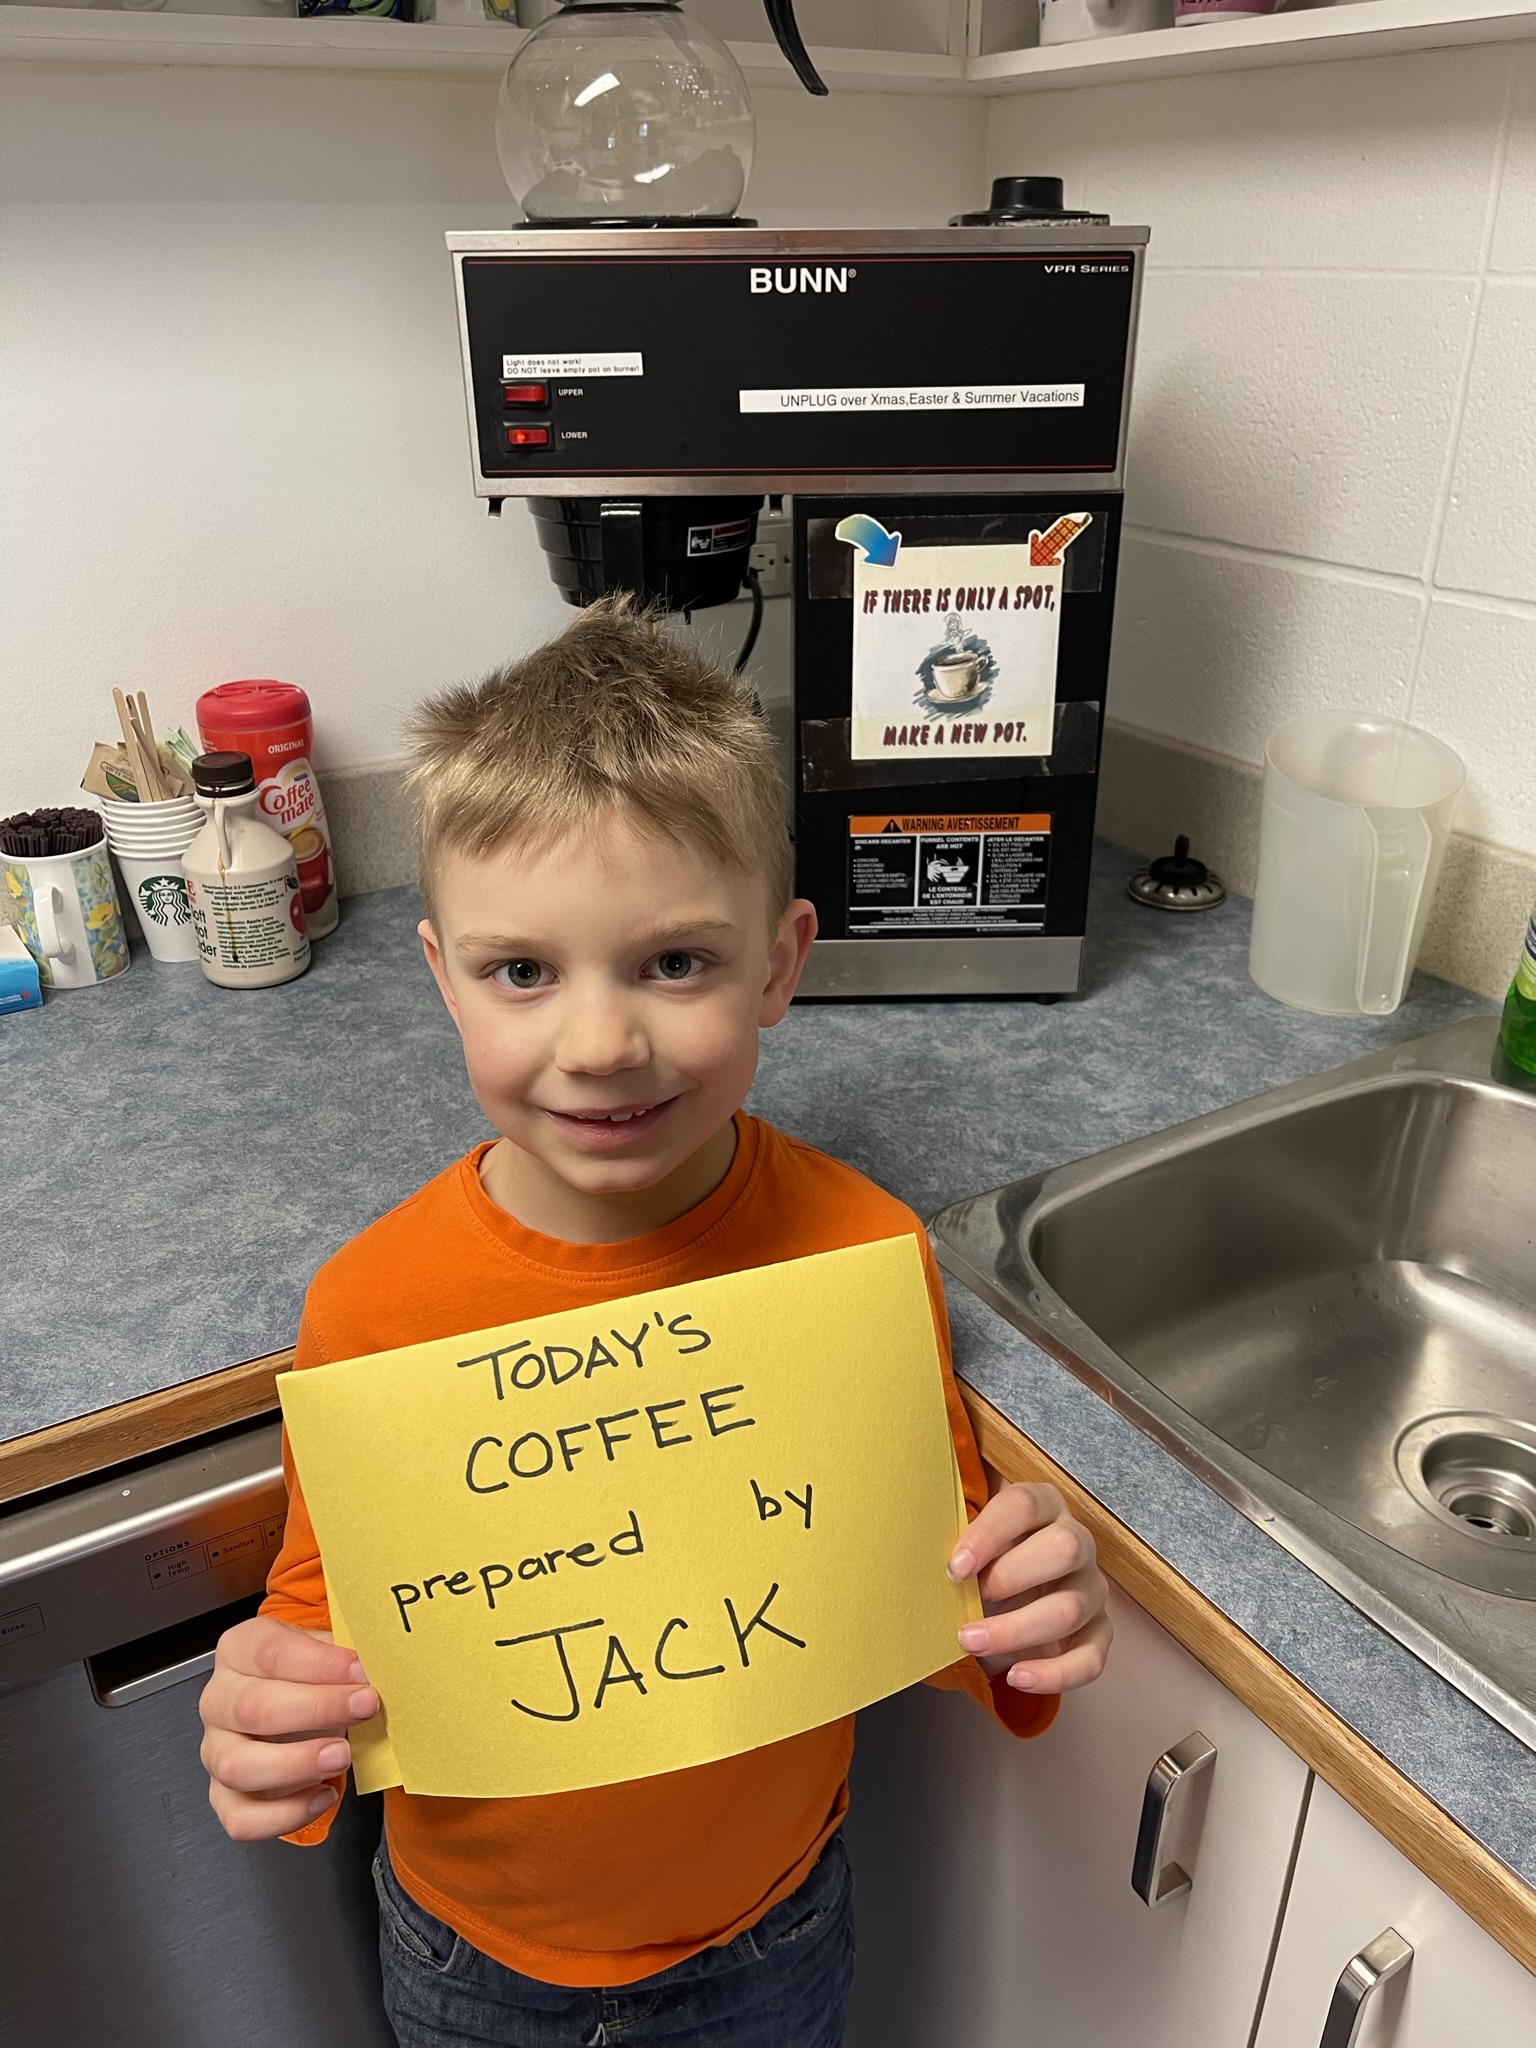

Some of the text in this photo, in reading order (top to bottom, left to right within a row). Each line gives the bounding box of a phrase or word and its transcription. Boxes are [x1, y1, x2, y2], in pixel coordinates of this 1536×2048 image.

[1044, 264, 1076, 274] VPR
[506, 357, 582, 368] Light does not work!
[507, 367, 519, 375] DO
[521, 366, 538, 375] NOT
[540, 366, 561, 374] leave
[563, 366, 586, 375] empty
[588, 365, 601, 374] pot
[613, 364, 640, 373] burner!
[558, 388, 584, 397] UPPER
[780, 393, 837, 407] UNPLUG
[840, 395, 867, 407] over
[951, 391, 962, 404] &
[964, 390, 1017, 404] Summer
[1019, 389, 1080, 403] Vacations
[561, 431, 588, 439] LOWER
[862, 583, 1056, 615] IF THERE IS ONLY A SPOT,
[882, 721, 1028, 747] MAKE A NEW POT.
[267, 738, 305, 755] ORIGINAL
[259, 780, 312, 815] Coffee
[280, 793, 315, 825] mate
[902, 816, 1020, 831] WARNING AVERTISSEMENT
[457, 1311, 712, 1400] TODAY'S
[465, 1384, 756, 1494] COFFEE
[145, 1540, 190, 1561] OPTIONS
[222, 1538, 256, 1554] Sanitize
[391, 1478, 814, 1633] prepared by
[167, 1559, 188, 1572] High
[167, 1565, 190, 1578] Temp
[0, 1621, 27, 1636] Rinse
[495, 1582, 807, 1722] JACK
